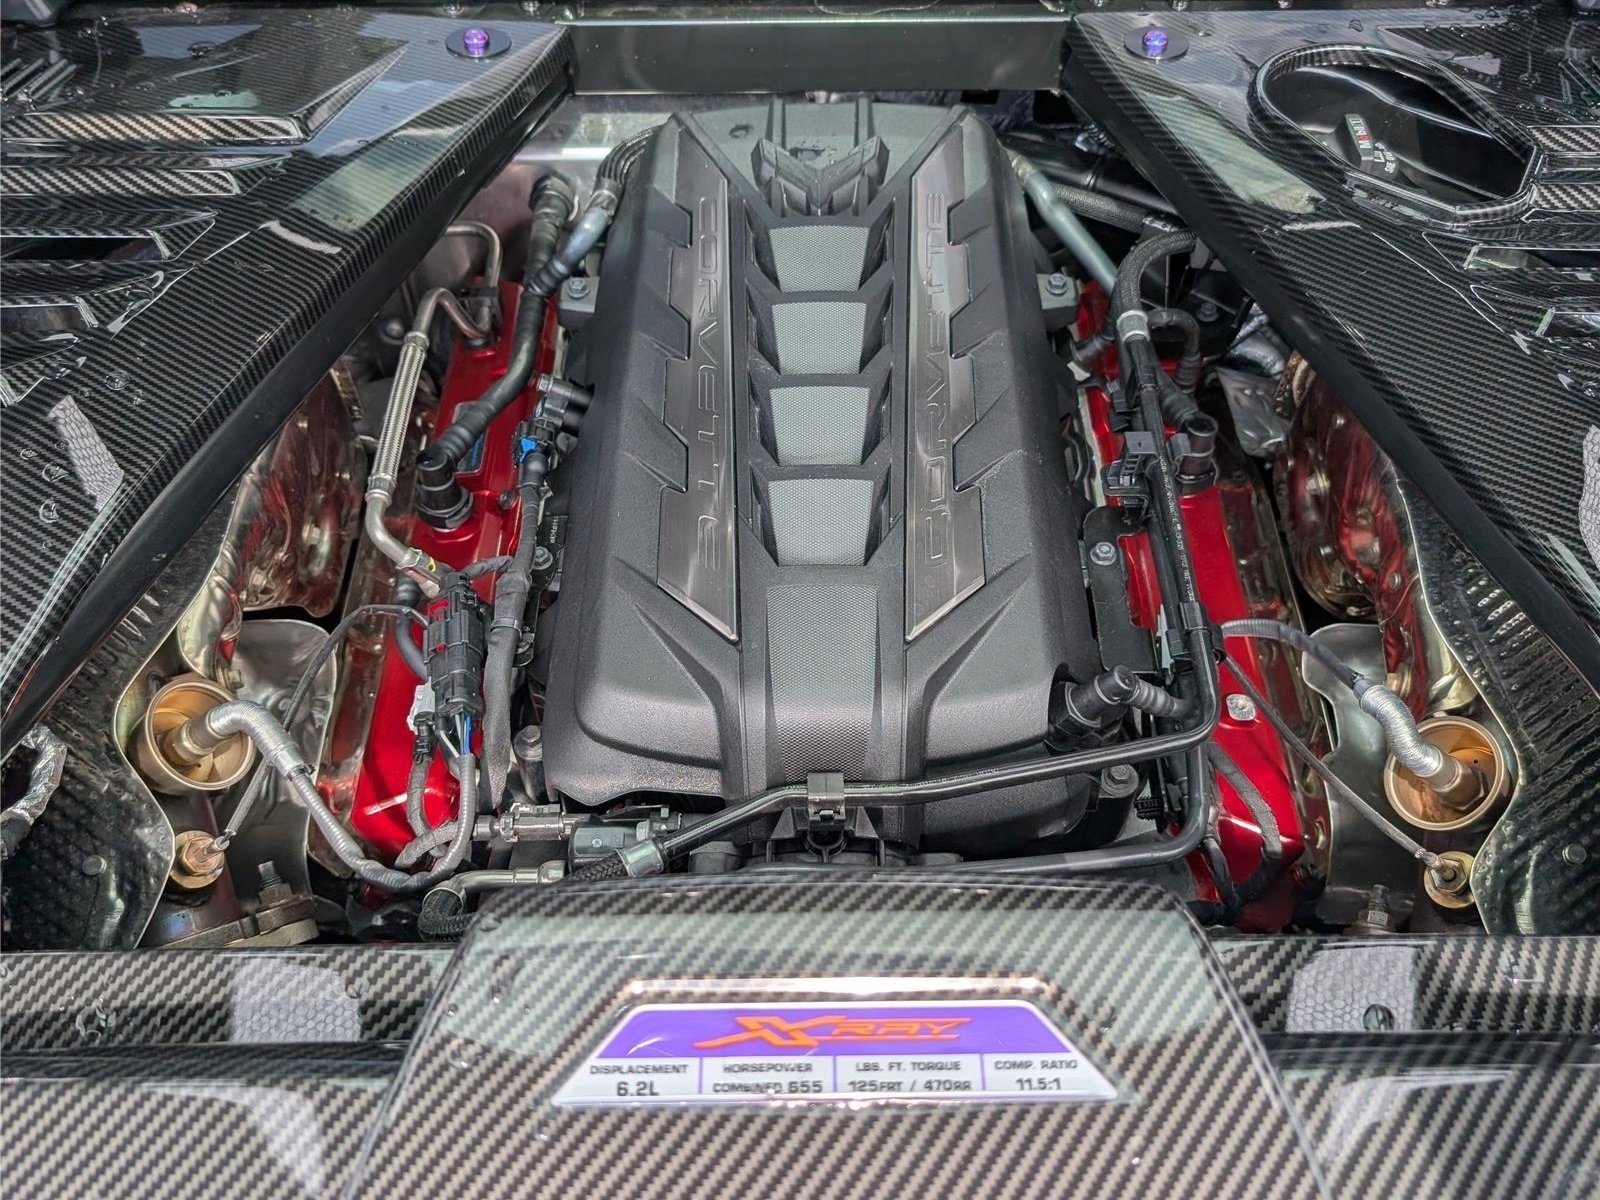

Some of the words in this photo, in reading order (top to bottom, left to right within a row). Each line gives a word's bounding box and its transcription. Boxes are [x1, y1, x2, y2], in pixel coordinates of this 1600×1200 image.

[1353, 127, 1372, 148] Mobil
[698, 196, 721, 571] CORVETTE
[924, 192, 947, 568] CORVETTE
[590, 1064, 688, 1075] DISPLACEMENT
[723, 1062, 813, 1073] HORSEPOWER
[856, 1061, 884, 1072] LBS.
[888, 1061, 907, 1071] FT.
[911, 1060, 962, 1071] TORQUE
[994, 1060, 1036, 1071] COMP.
[1040, 1059, 1078, 1070] RATIO
[616, 1081, 660, 1097] 6.2L
[712, 1082, 783, 1094] COMBINED
[788, 1080, 824, 1094] 655
[1016, 1078, 1061, 1091] 11.5:1
